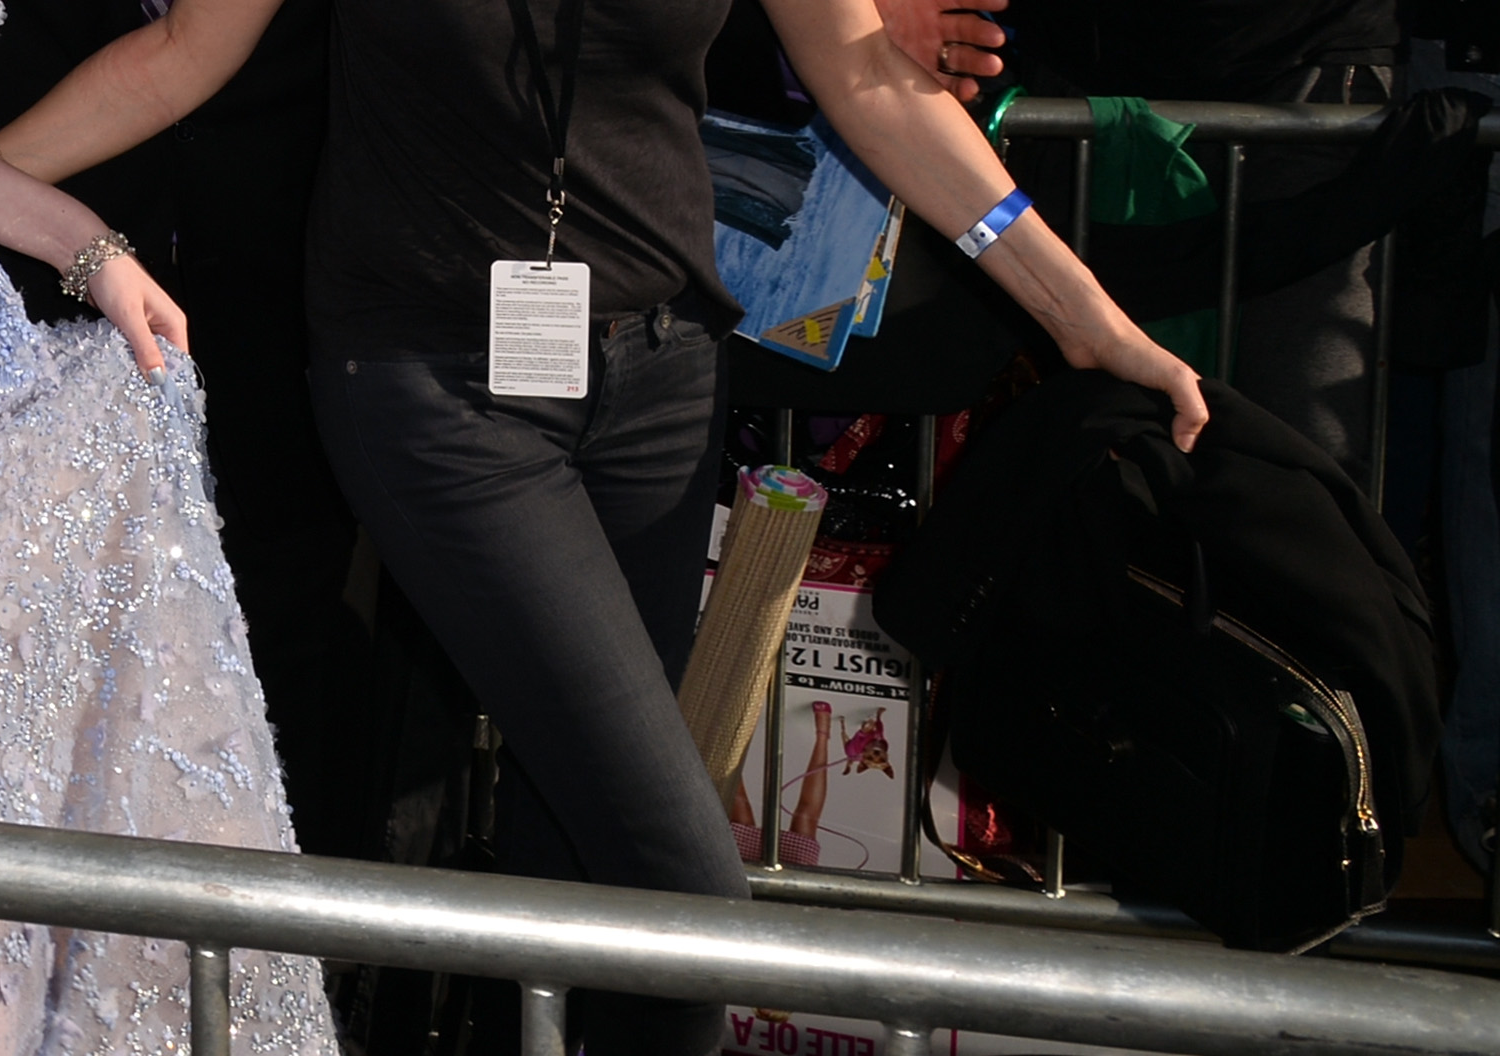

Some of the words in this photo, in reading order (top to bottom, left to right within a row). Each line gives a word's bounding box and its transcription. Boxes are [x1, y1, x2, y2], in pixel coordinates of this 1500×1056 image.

[785, 620, 810, 632] SAVE
[812, 624, 831, 636] AND
[847, 628, 880, 641] ORDER
[796, 674, 815, 686] to
[819, 679, 885, 695] "SHOW"
[730, 1012, 753, 1045] A
[757, 1021, 797, 1055] OF
